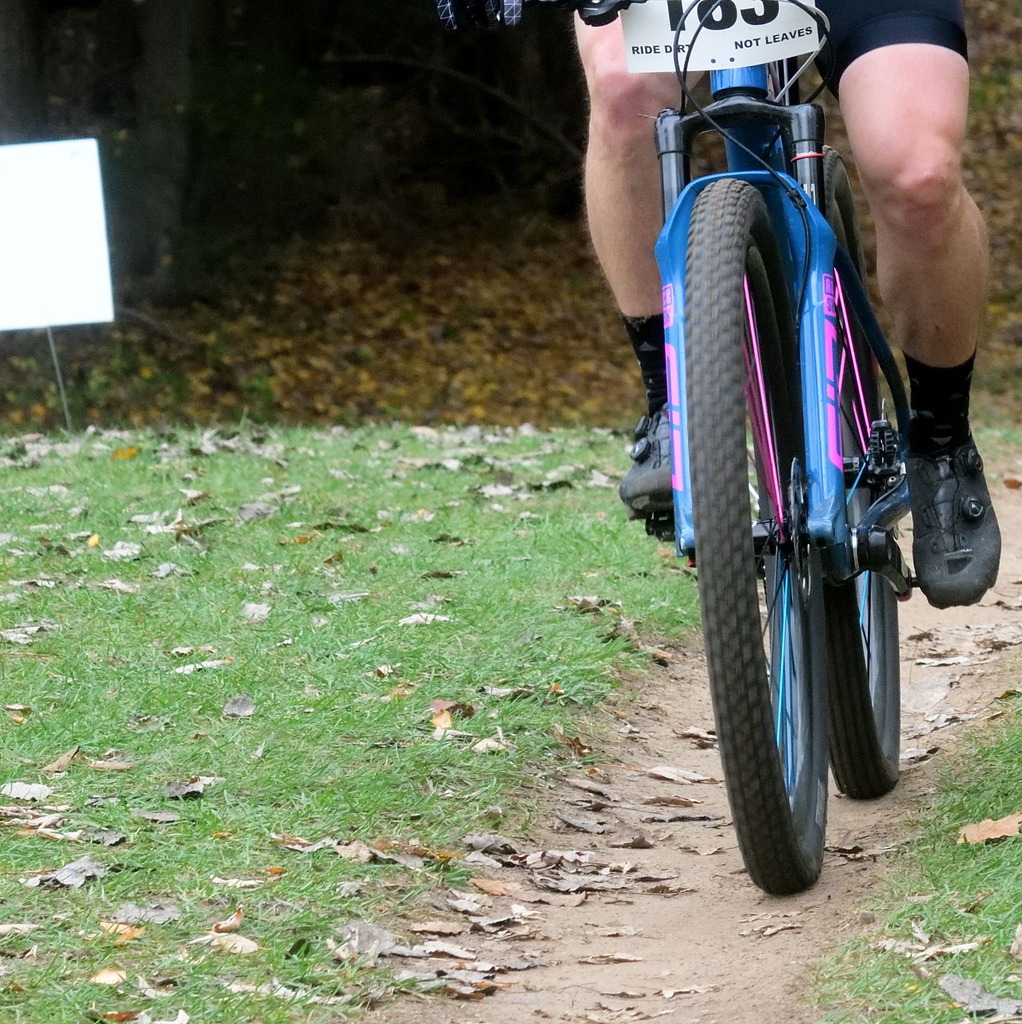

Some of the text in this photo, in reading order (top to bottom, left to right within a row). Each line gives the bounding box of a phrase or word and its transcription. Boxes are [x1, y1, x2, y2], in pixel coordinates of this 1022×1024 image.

[734, 26, 813, 50] NOT LEAVES
[631, 44, 694, 55] RIDE DRT
